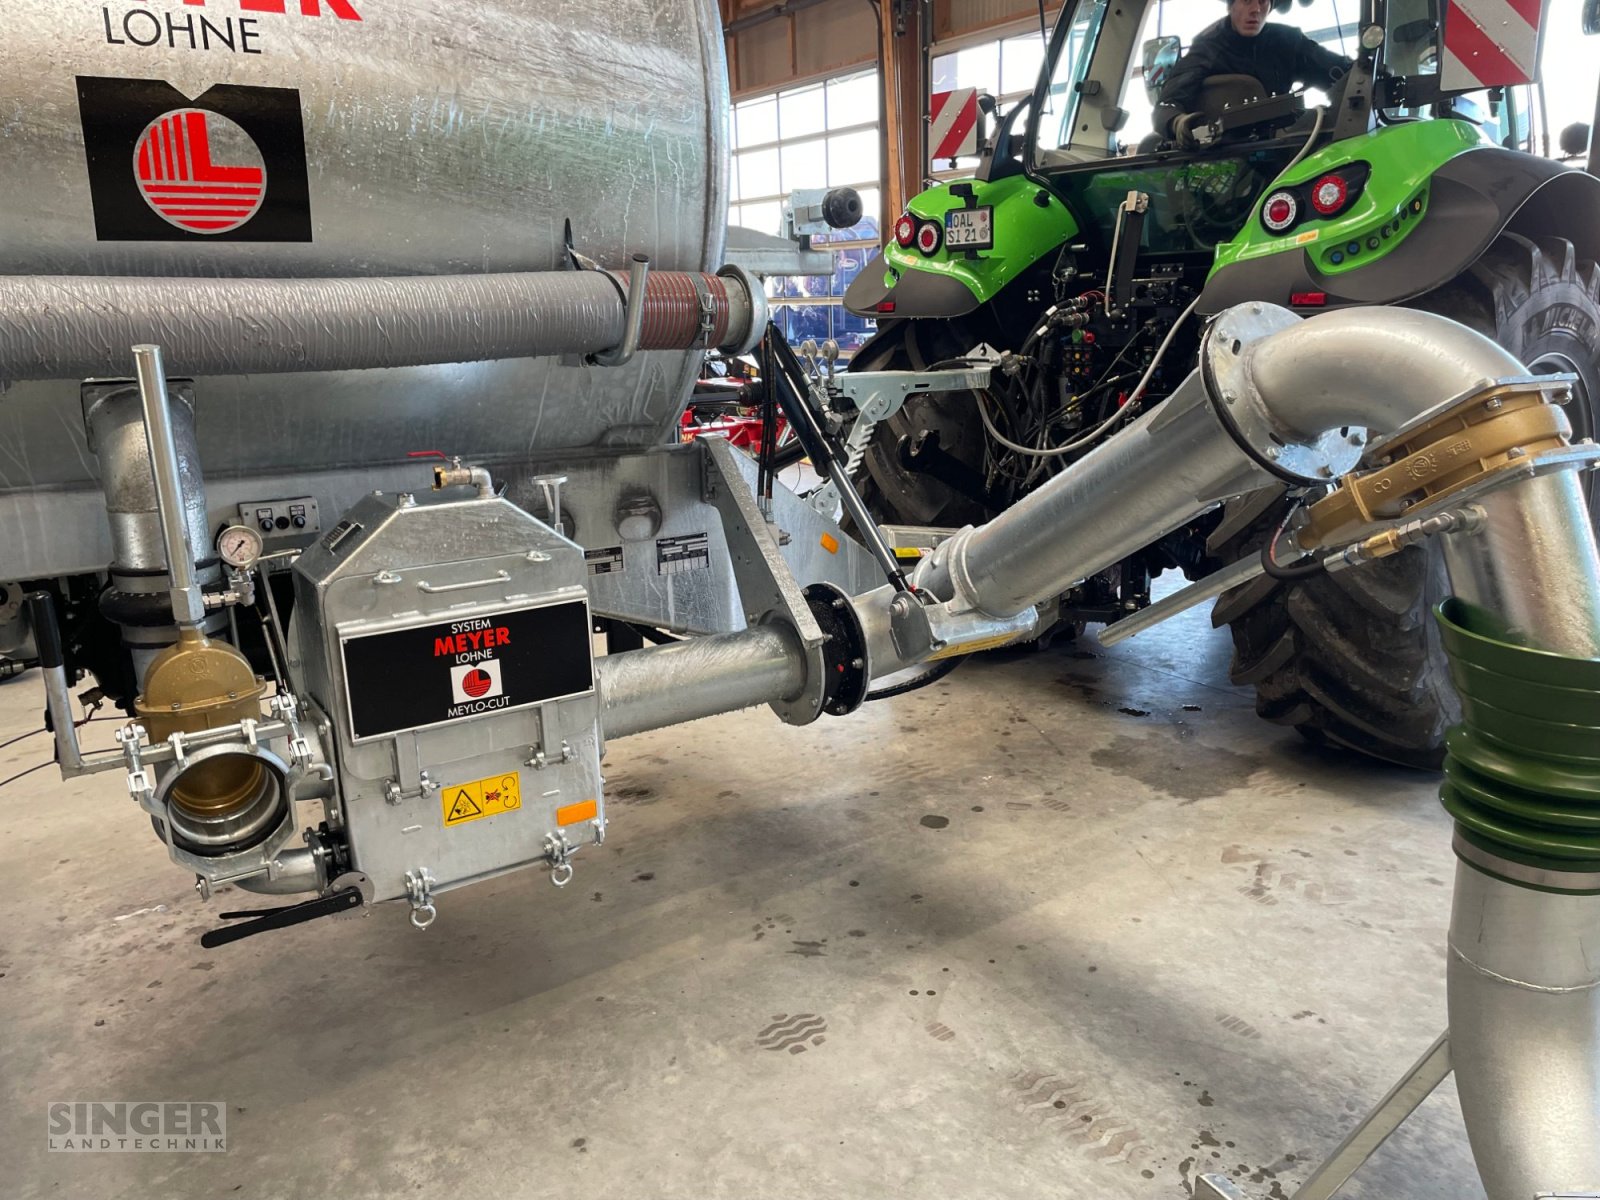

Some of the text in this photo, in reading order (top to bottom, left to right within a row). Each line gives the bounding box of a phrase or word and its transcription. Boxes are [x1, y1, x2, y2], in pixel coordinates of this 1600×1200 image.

[102, 7, 262, 54] LOHNE
[953, 213, 973, 228] OAL
[964, 228, 977, 242] 21
[451, 619, 491, 634] SYSTEM
[434, 627, 511, 657] MEYER
[455, 648, 493, 665] LOHNE
[447, 696, 511, 718] MEYLO-CUT
